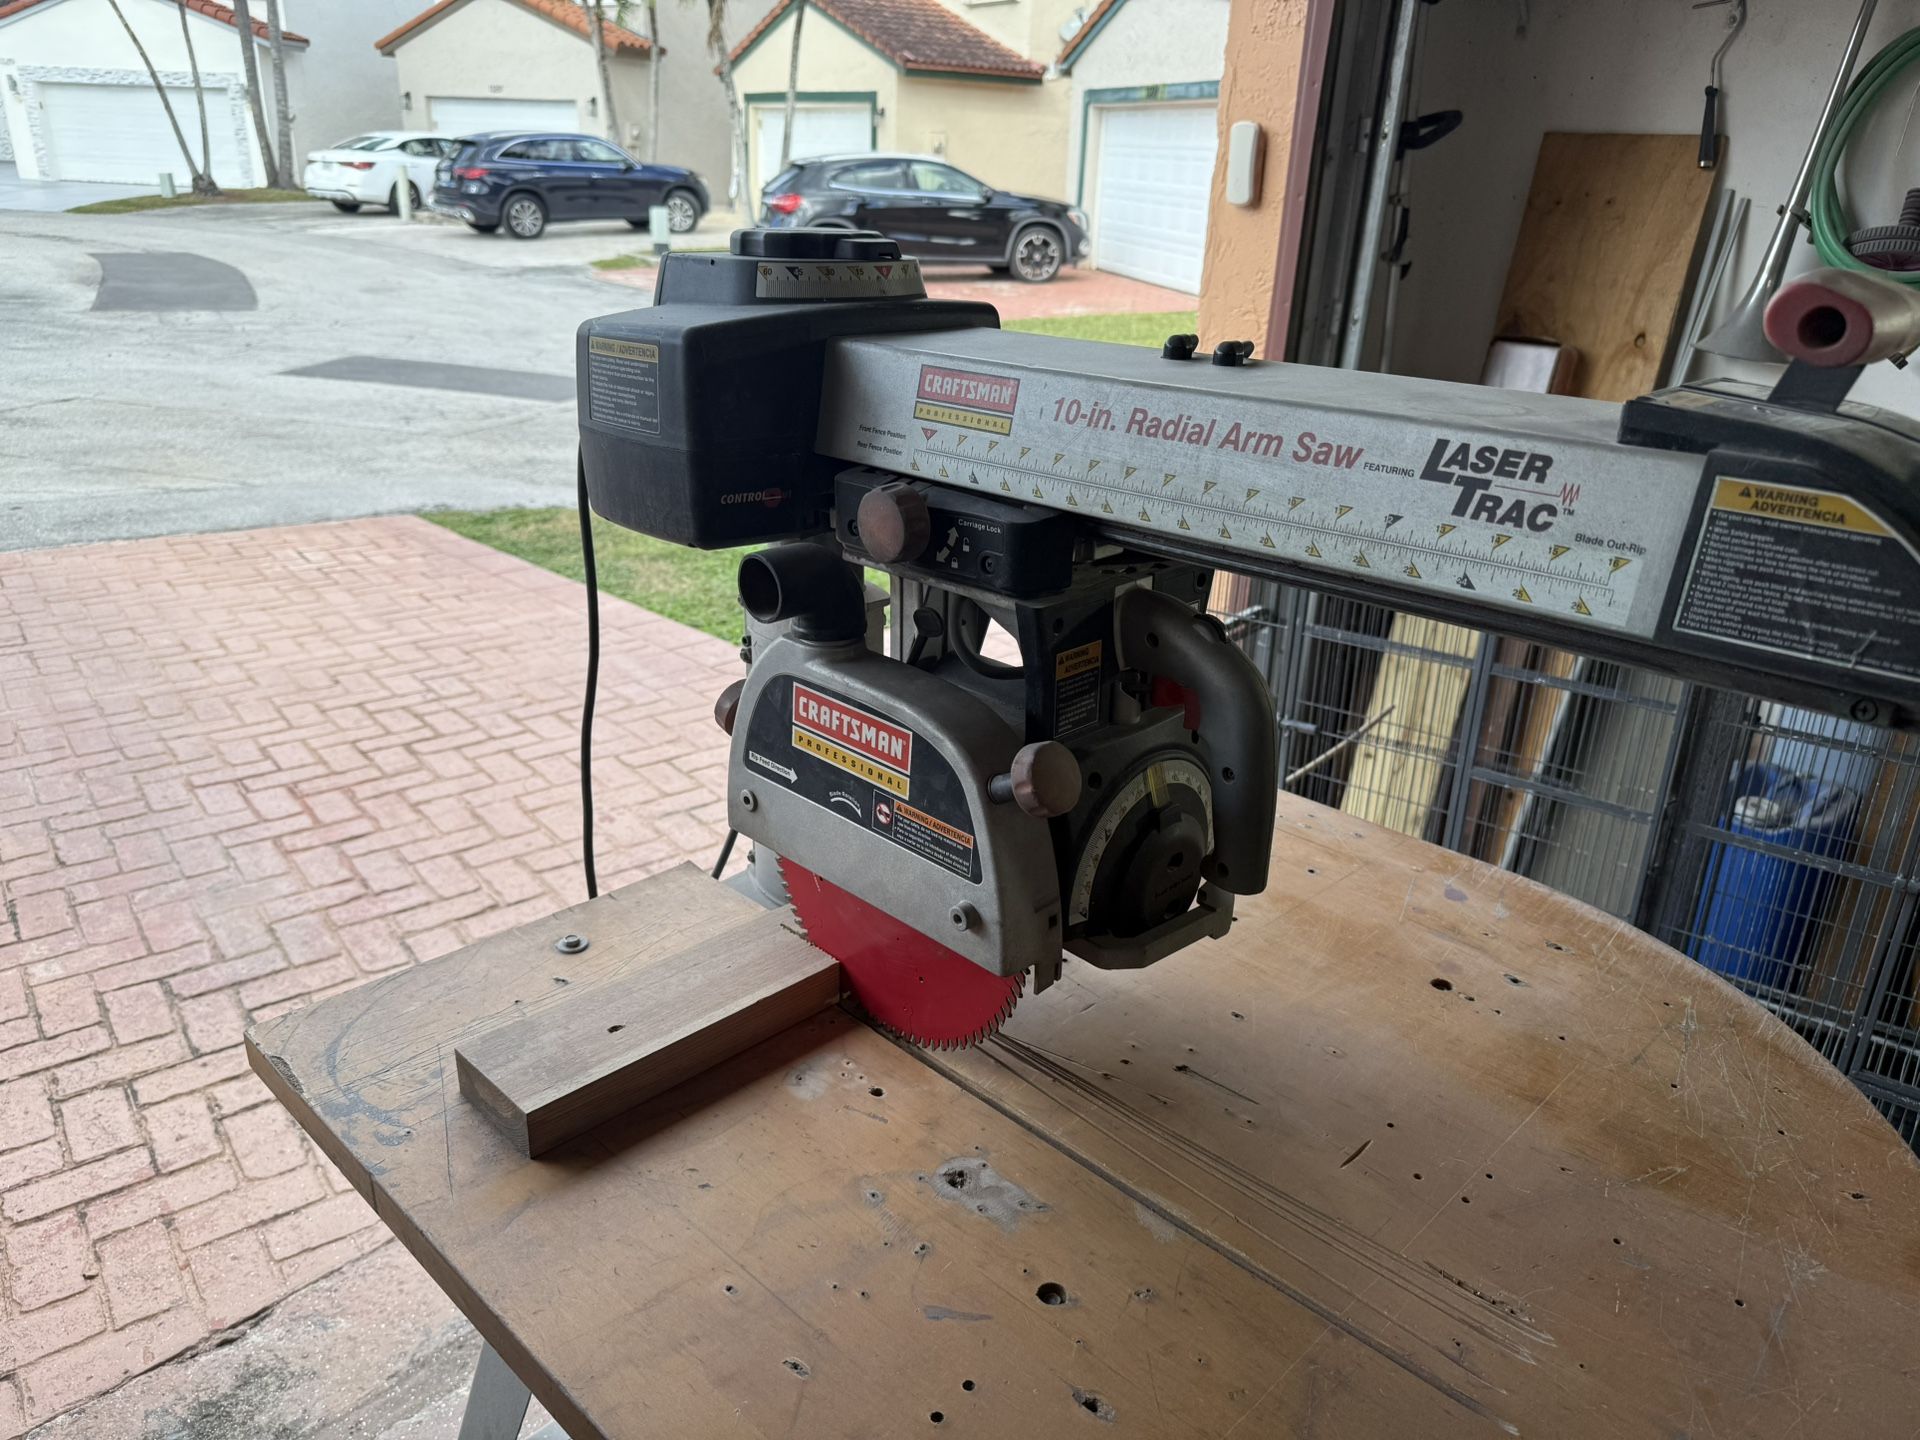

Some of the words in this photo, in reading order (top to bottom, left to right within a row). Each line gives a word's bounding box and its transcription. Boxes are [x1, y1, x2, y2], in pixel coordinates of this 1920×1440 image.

[924, 374, 1012, 404] CRAFTSMAN
[919, 407, 1006, 430] PROFESSIONAL
[1053, 397, 1116, 431] 10-in.
[1125, 407, 1217, 447] Radial
[1218, 422, 1284, 458] Arm
[1292, 432, 1364, 469] Saw
[1363, 462, 1415, 478] FEATURING
[1420, 438, 1554, 484] LASER
[1452, 474, 1558, 532] TRAC
[1750, 500, 1845, 524] ADVERTENCIA
[1754, 488, 1818, 507] WARNING
[958, 519, 985, 530] Carriage
[986, 525, 1001, 534] Lock
[1575, 532, 1604, 547] Blade
[1607, 539, 1647, 556] Out-Rip
[1609, 558, 1620, 568] 16
[1403, 566, 1414, 574] 23
[1512, 589, 1524, 598] 25
[798, 696, 902, 760] CRAFTSMAN
[760, 756, 770, 766] Feed
[771, 761, 791, 776] Direction
[798, 736, 902, 790] PROFESSIONAL
[904, 807, 928, 826] WARNING
[932, 820, 971, 846] ADVERTENCIA
